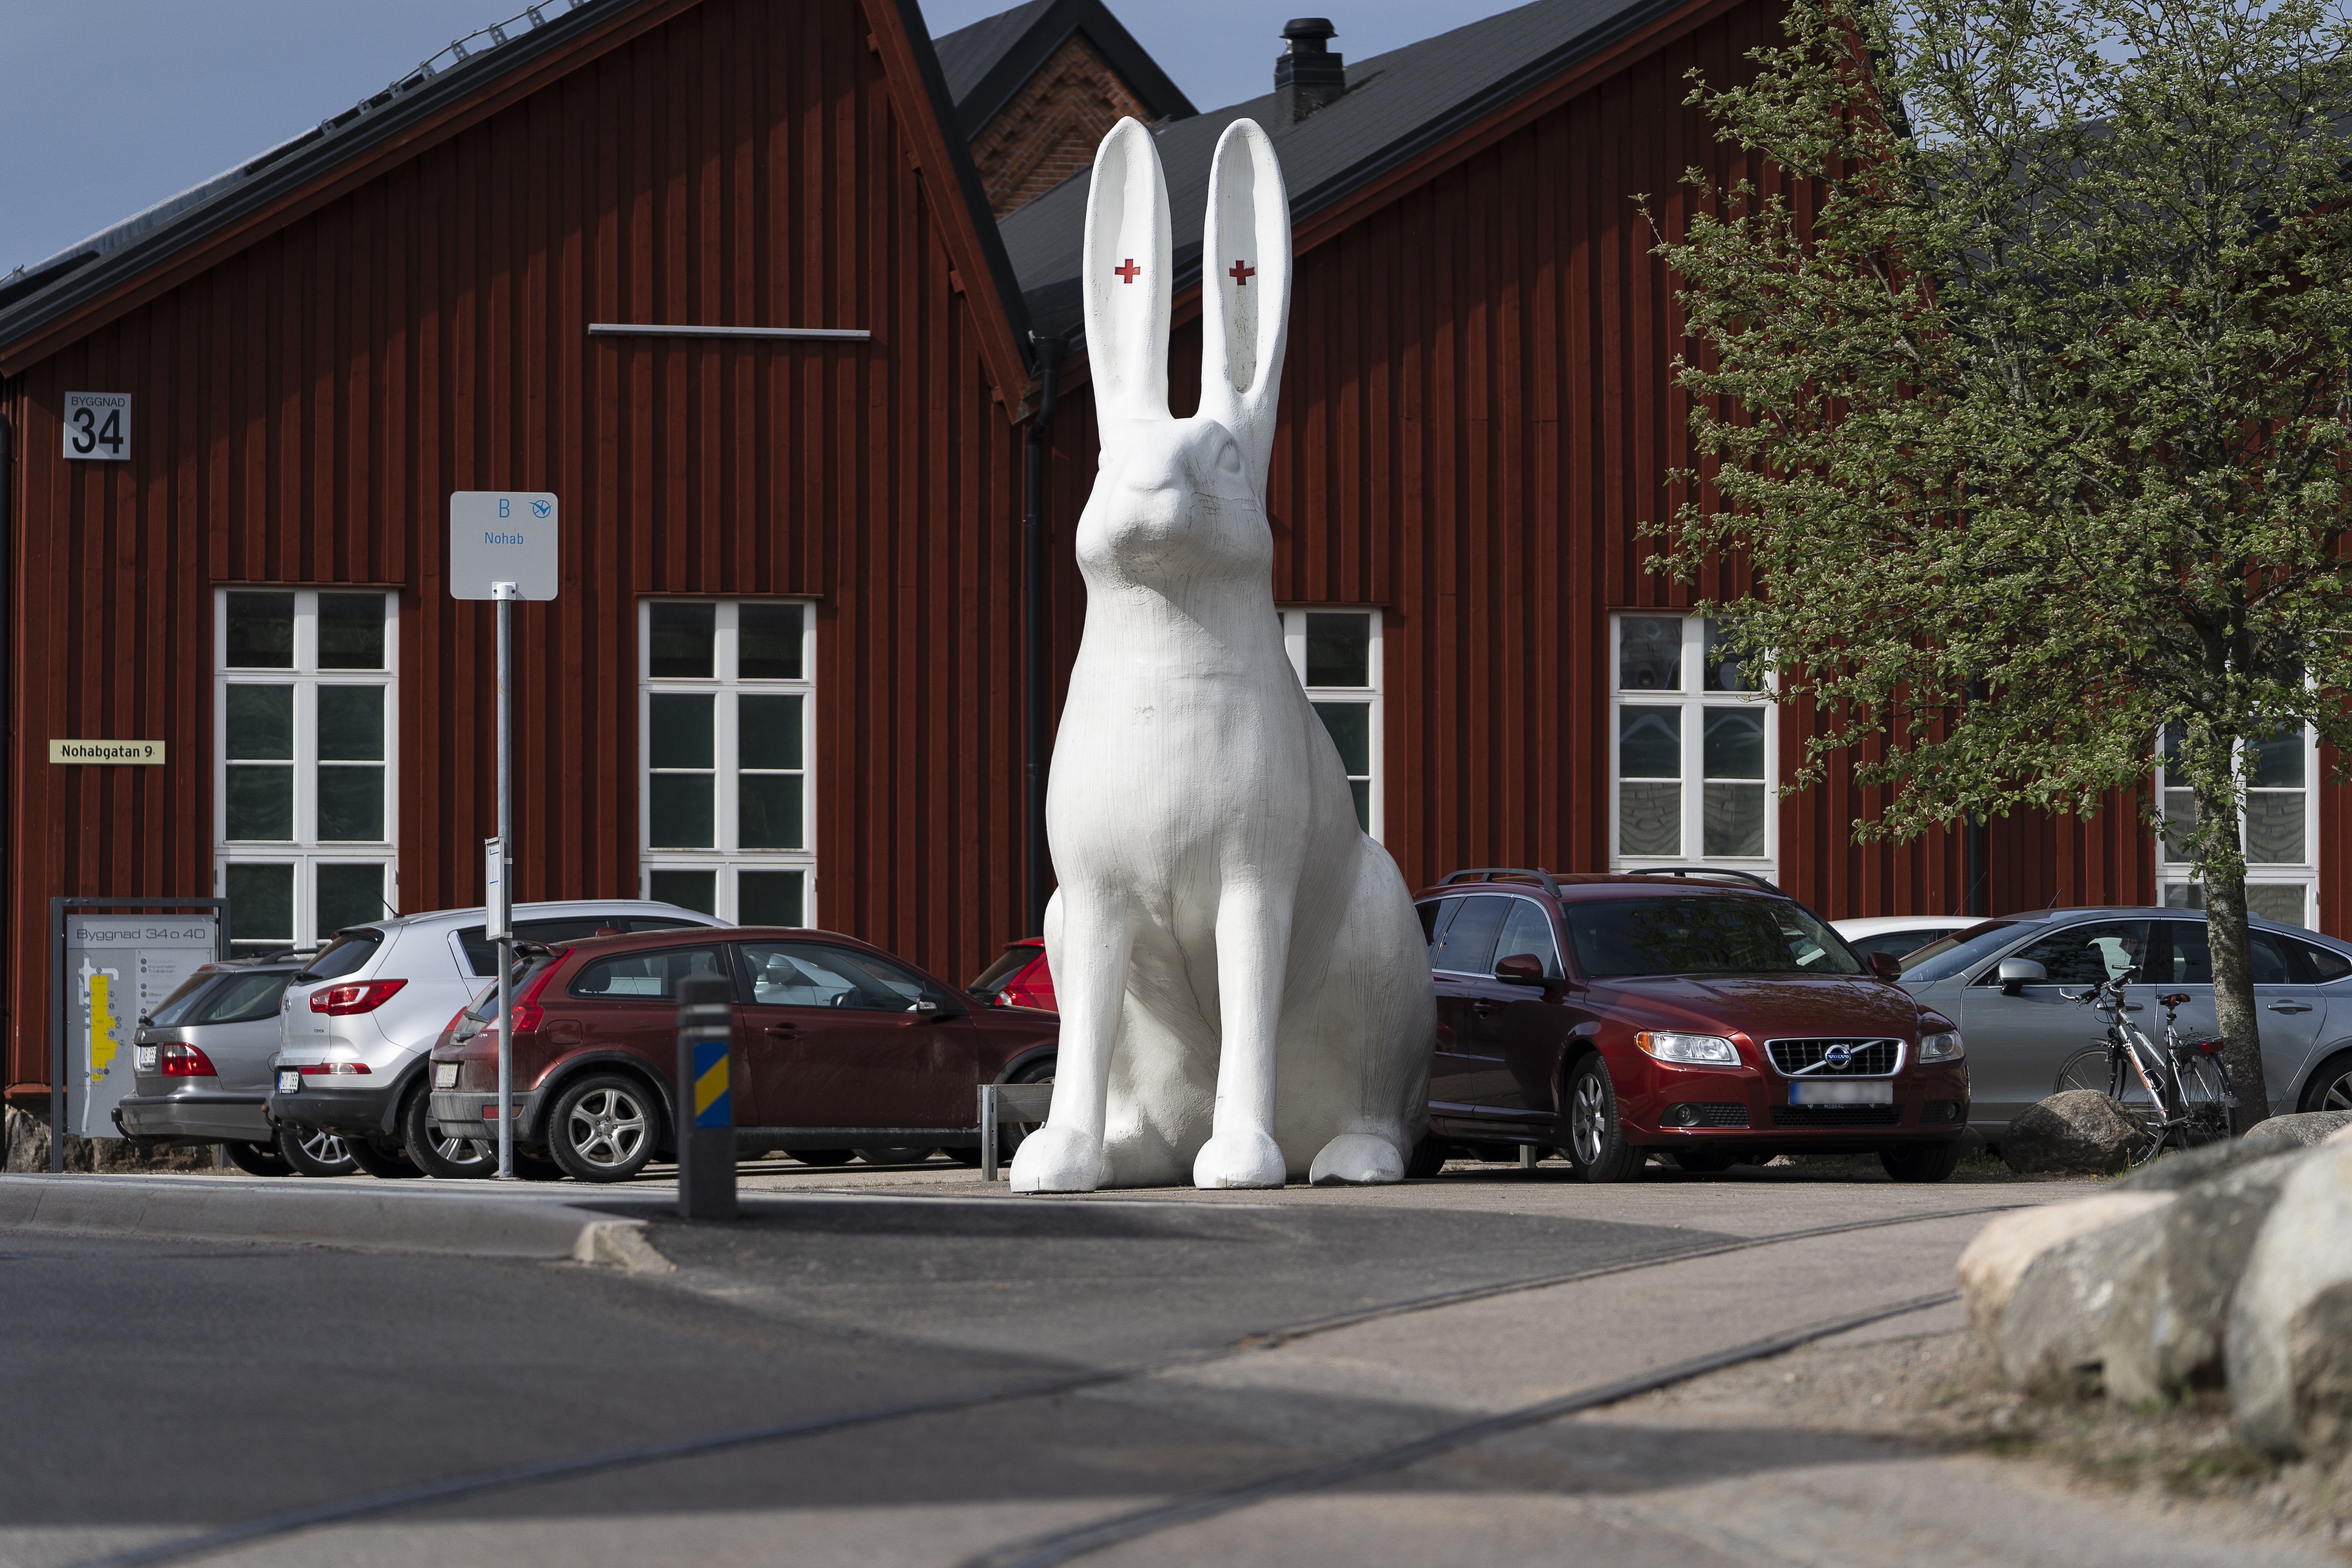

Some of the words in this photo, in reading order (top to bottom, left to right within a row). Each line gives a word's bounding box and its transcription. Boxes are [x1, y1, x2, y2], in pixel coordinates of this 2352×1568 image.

[71, 396, 126, 407] BYGGNAD
[72, 407, 124, 454] 34
[499, 498, 510, 518] B
[484, 532, 524, 545] Nohab
[62, 745, 140, 760] Nohabgatan
[144, 745, 153, 757] 9
[76, 928, 141, 941] Byggnad
[145, 928, 168, 939] 34
[183, 928, 206, 939] 40
